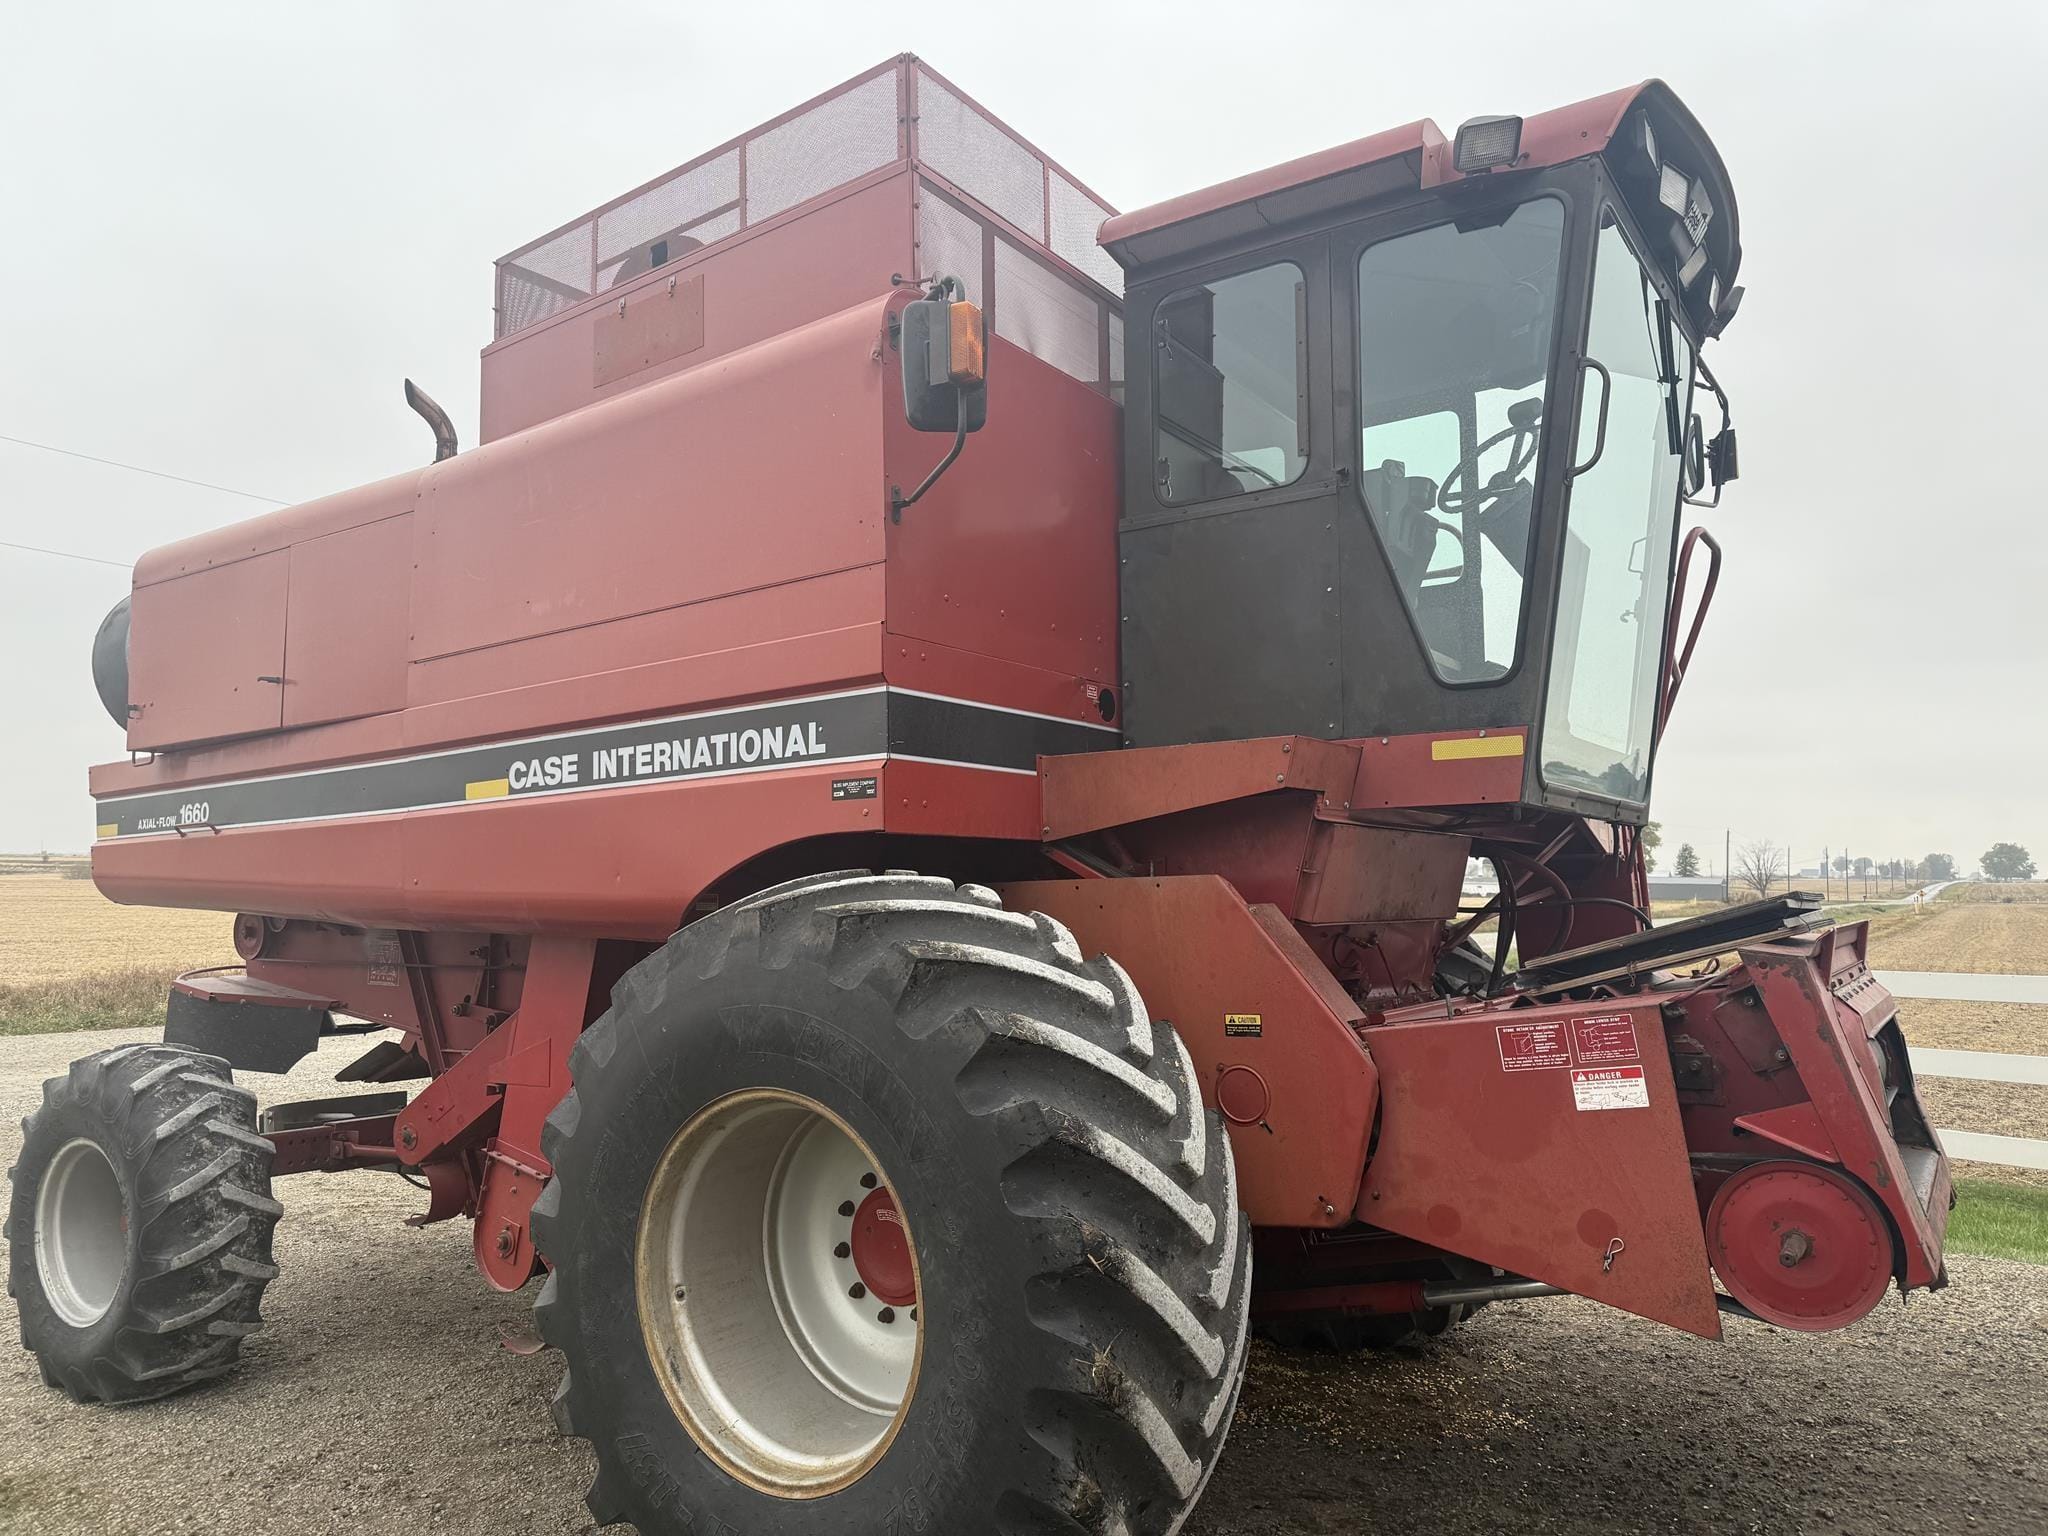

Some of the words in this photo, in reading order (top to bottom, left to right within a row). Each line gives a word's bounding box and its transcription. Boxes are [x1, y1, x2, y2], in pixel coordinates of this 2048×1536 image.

[508, 753, 579, 790] CASE
[592, 721, 826, 780] INTERNATIONAL
[179, 802, 210, 824] 1660
[1588, 1071, 1622, 1081] DANGER
